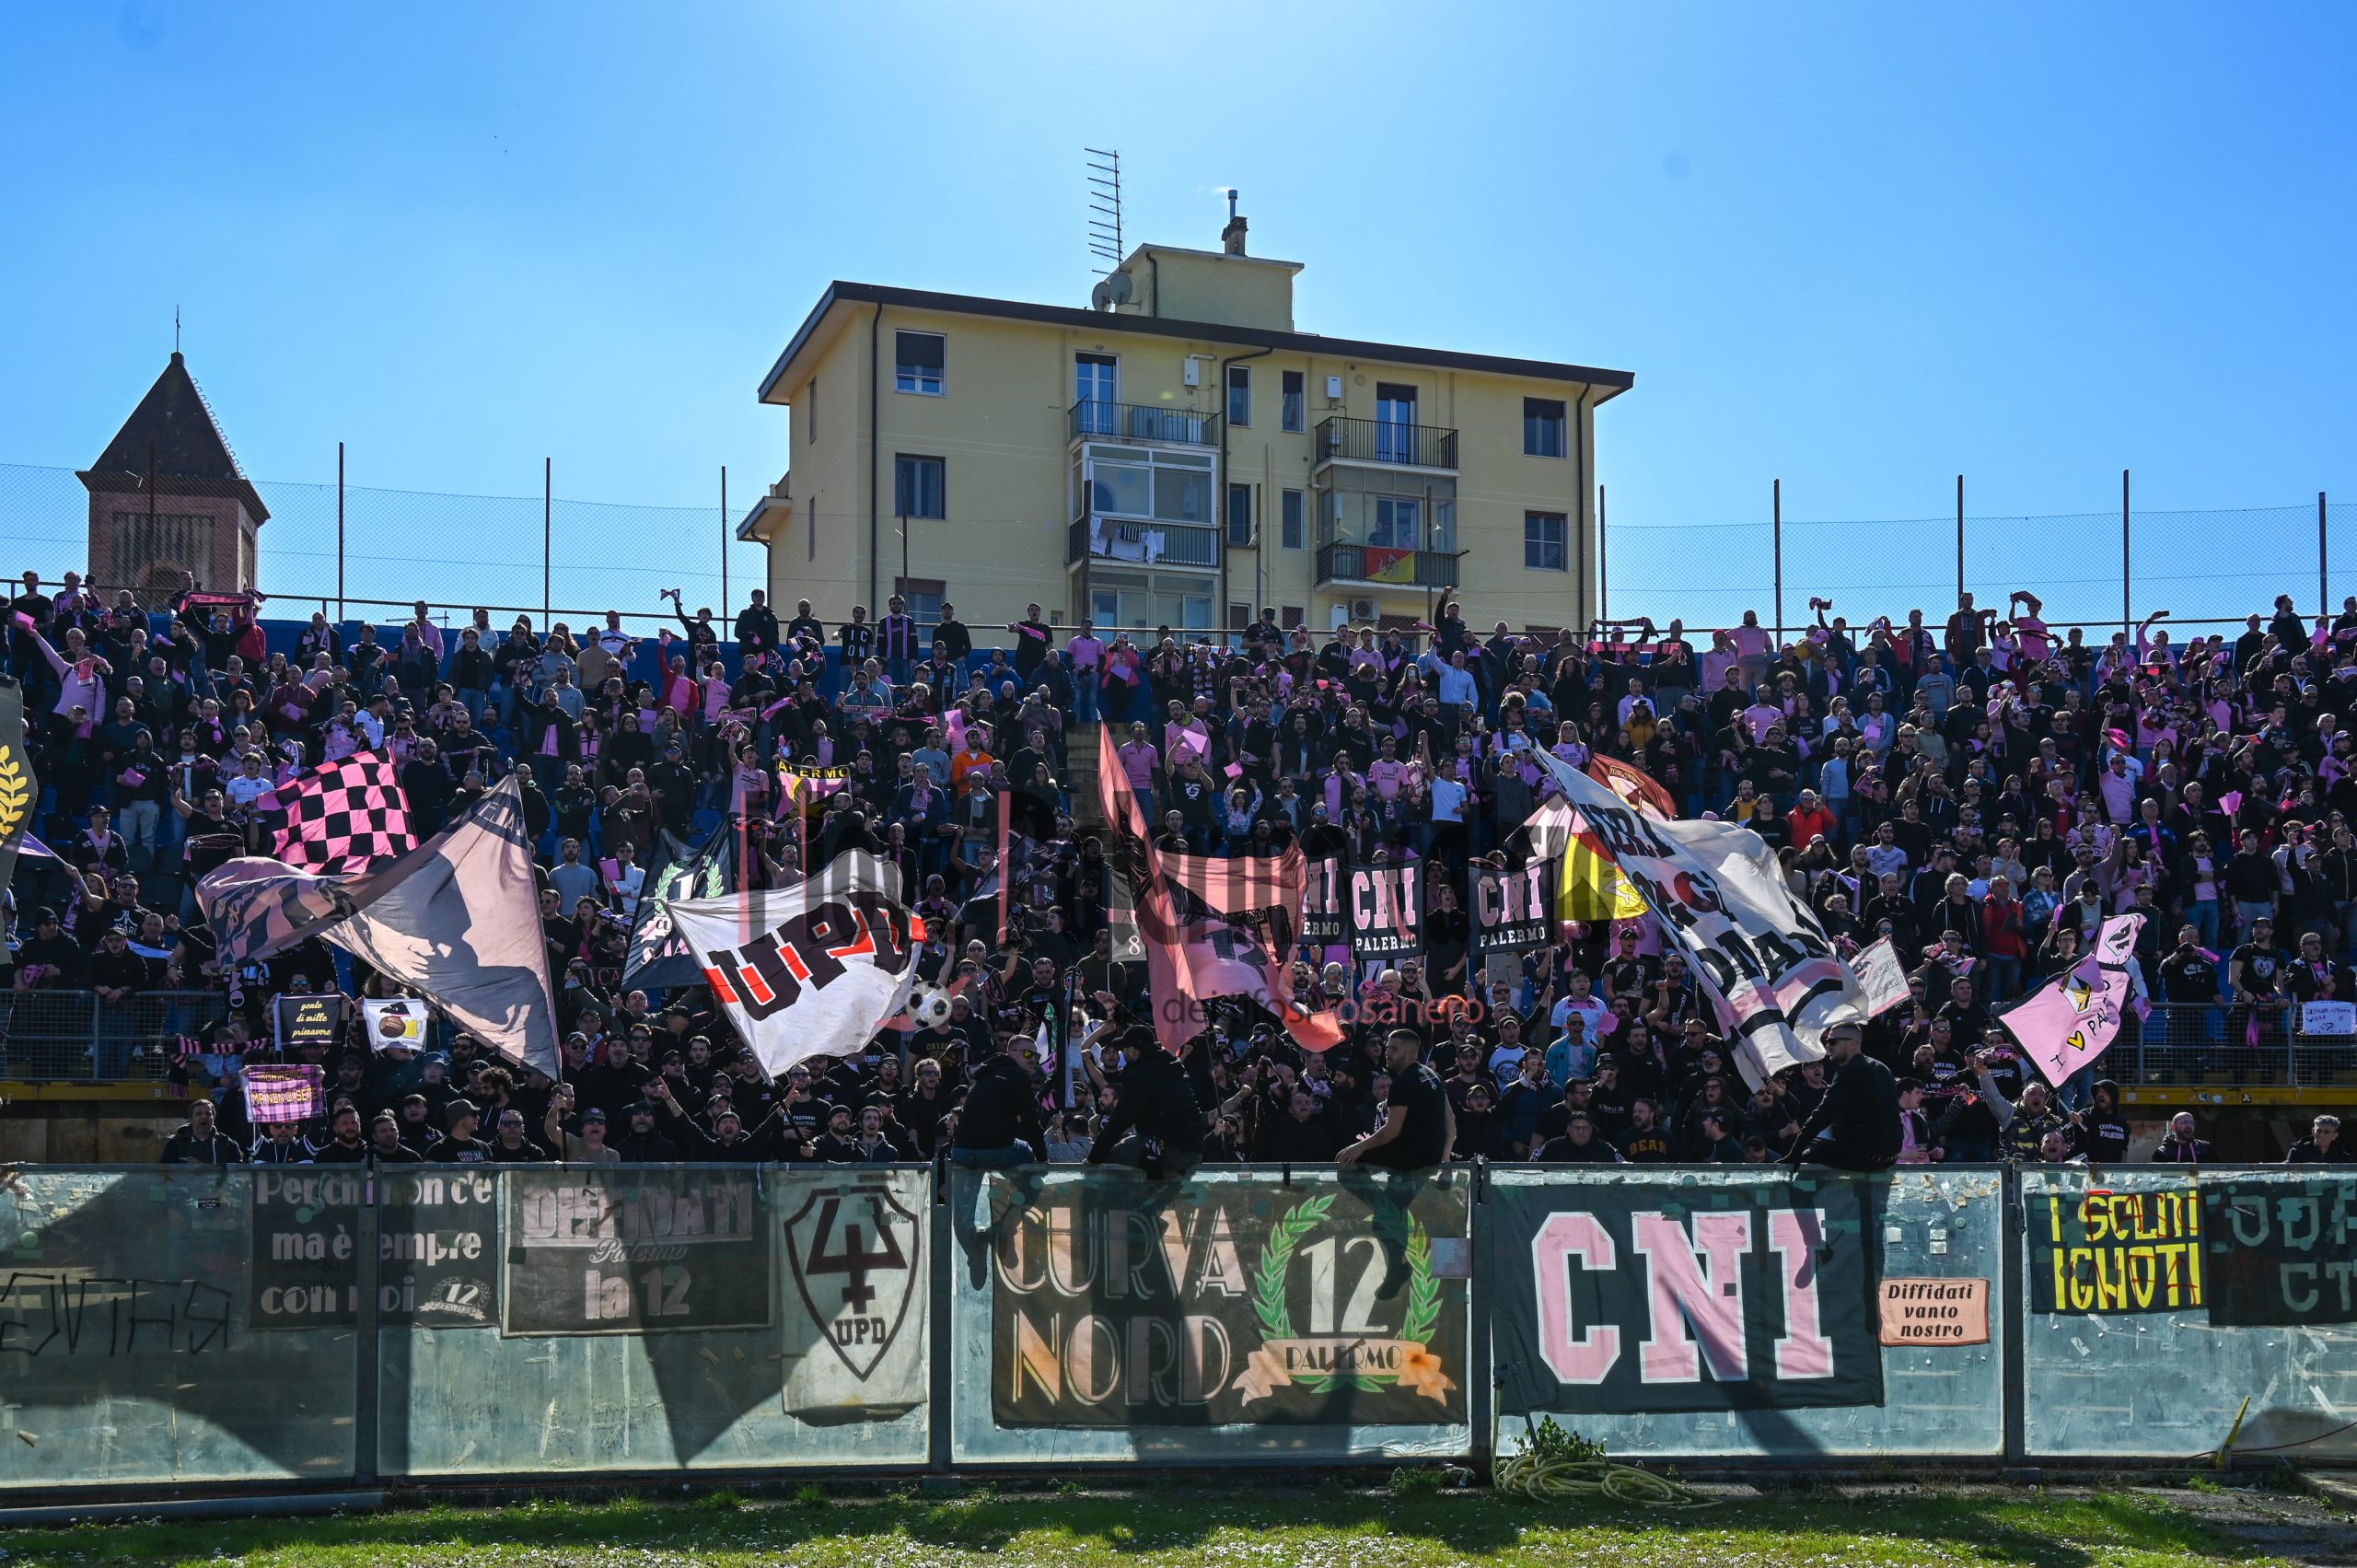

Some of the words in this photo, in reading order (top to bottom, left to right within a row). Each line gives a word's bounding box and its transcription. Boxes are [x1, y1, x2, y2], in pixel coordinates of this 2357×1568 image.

[1302, 857, 1341, 914] NI
[1352, 866, 1416, 931] CNI
[1479, 865, 1544, 928] CNI
[1302, 918, 1340, 936] ERMO
[1355, 934, 1417, 952] PALERMO
[1480, 925, 1547, 948] PALERMO
[273, 1232, 325, 1260] ma
[380, 1231, 482, 1266] empre
[589, 1237, 688, 1264] Palermo
[995, 1204, 1248, 1299] CURVA
[585, 1270, 630, 1320] la
[640, 1264, 691, 1317] 12
[1301, 1236, 1389, 1333] 12
[1887, 1283, 1973, 1301] Diffidati
[2053, 1243, 2202, 1311] IGNOTI
[261, 1285, 337, 1314] con
[1531, 1208, 1834, 1385] CNI
[1904, 1303, 1959, 1319] vanto
[834, 1317, 887, 1346] UPD
[1899, 1321, 1965, 1339] nostro
[1014, 1308, 1231, 1407] NORD
[1286, 1343, 1403, 1371] PALERMO
